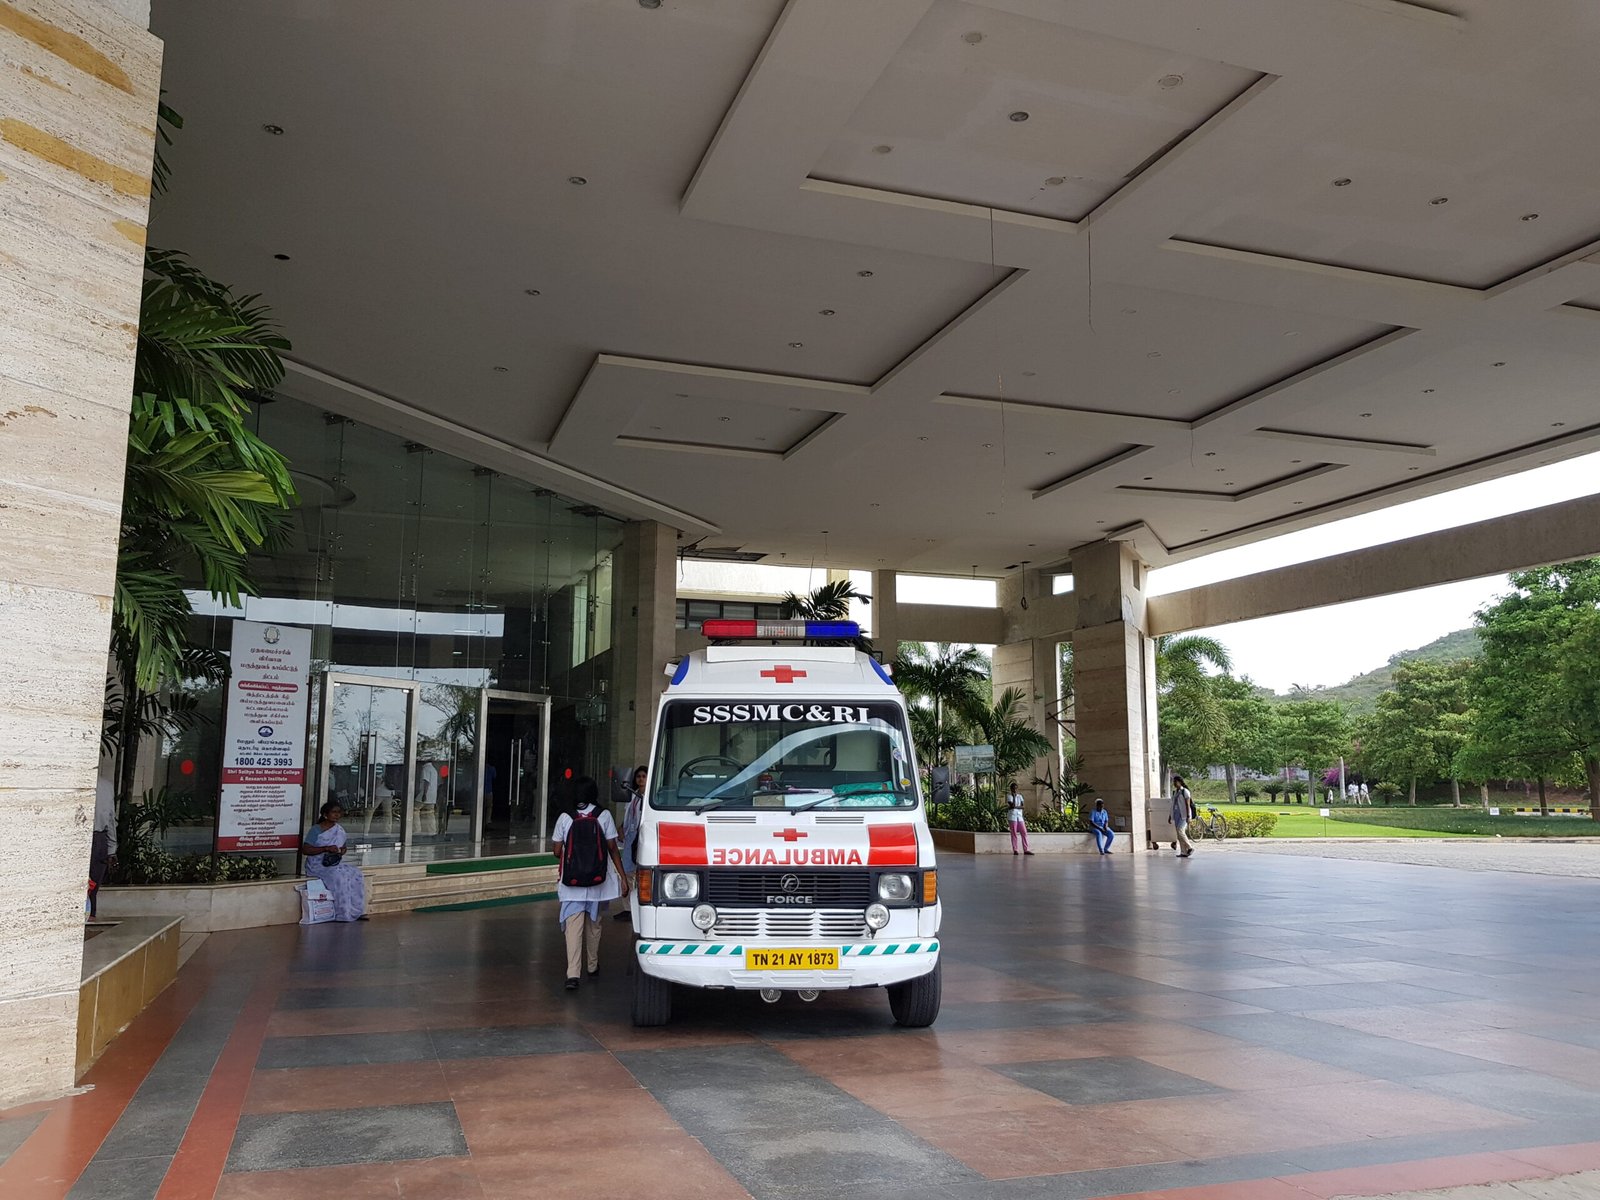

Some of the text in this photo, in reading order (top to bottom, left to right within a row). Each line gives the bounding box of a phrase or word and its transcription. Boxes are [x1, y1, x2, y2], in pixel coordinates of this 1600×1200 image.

[693, 704, 870, 724] SSSMC&RI
[766, 895, 813, 904] FORCE
[752, 952, 834, 966] TN 21 AY 1873
